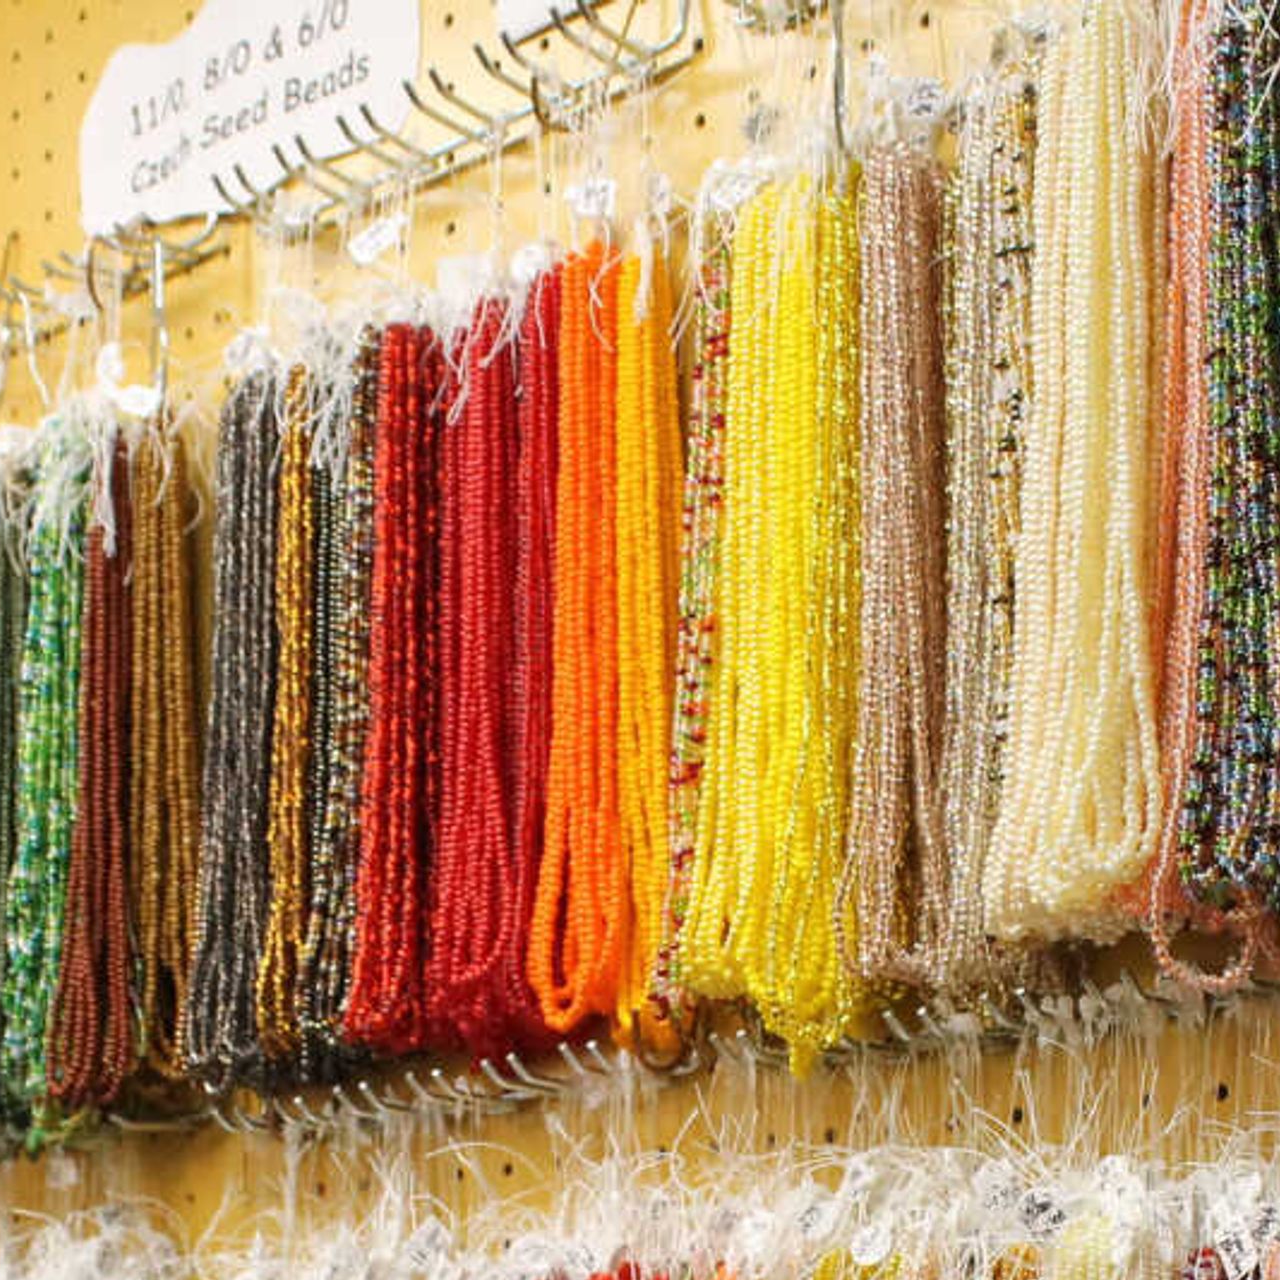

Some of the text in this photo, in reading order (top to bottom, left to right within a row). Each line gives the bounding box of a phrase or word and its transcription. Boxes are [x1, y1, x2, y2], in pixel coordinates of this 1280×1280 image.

[263, 25, 285, 62] &
[298, 0, 349, 47] 6/0
[200, 86, 270, 149] Seed
[282, 49, 370, 113] Beads
